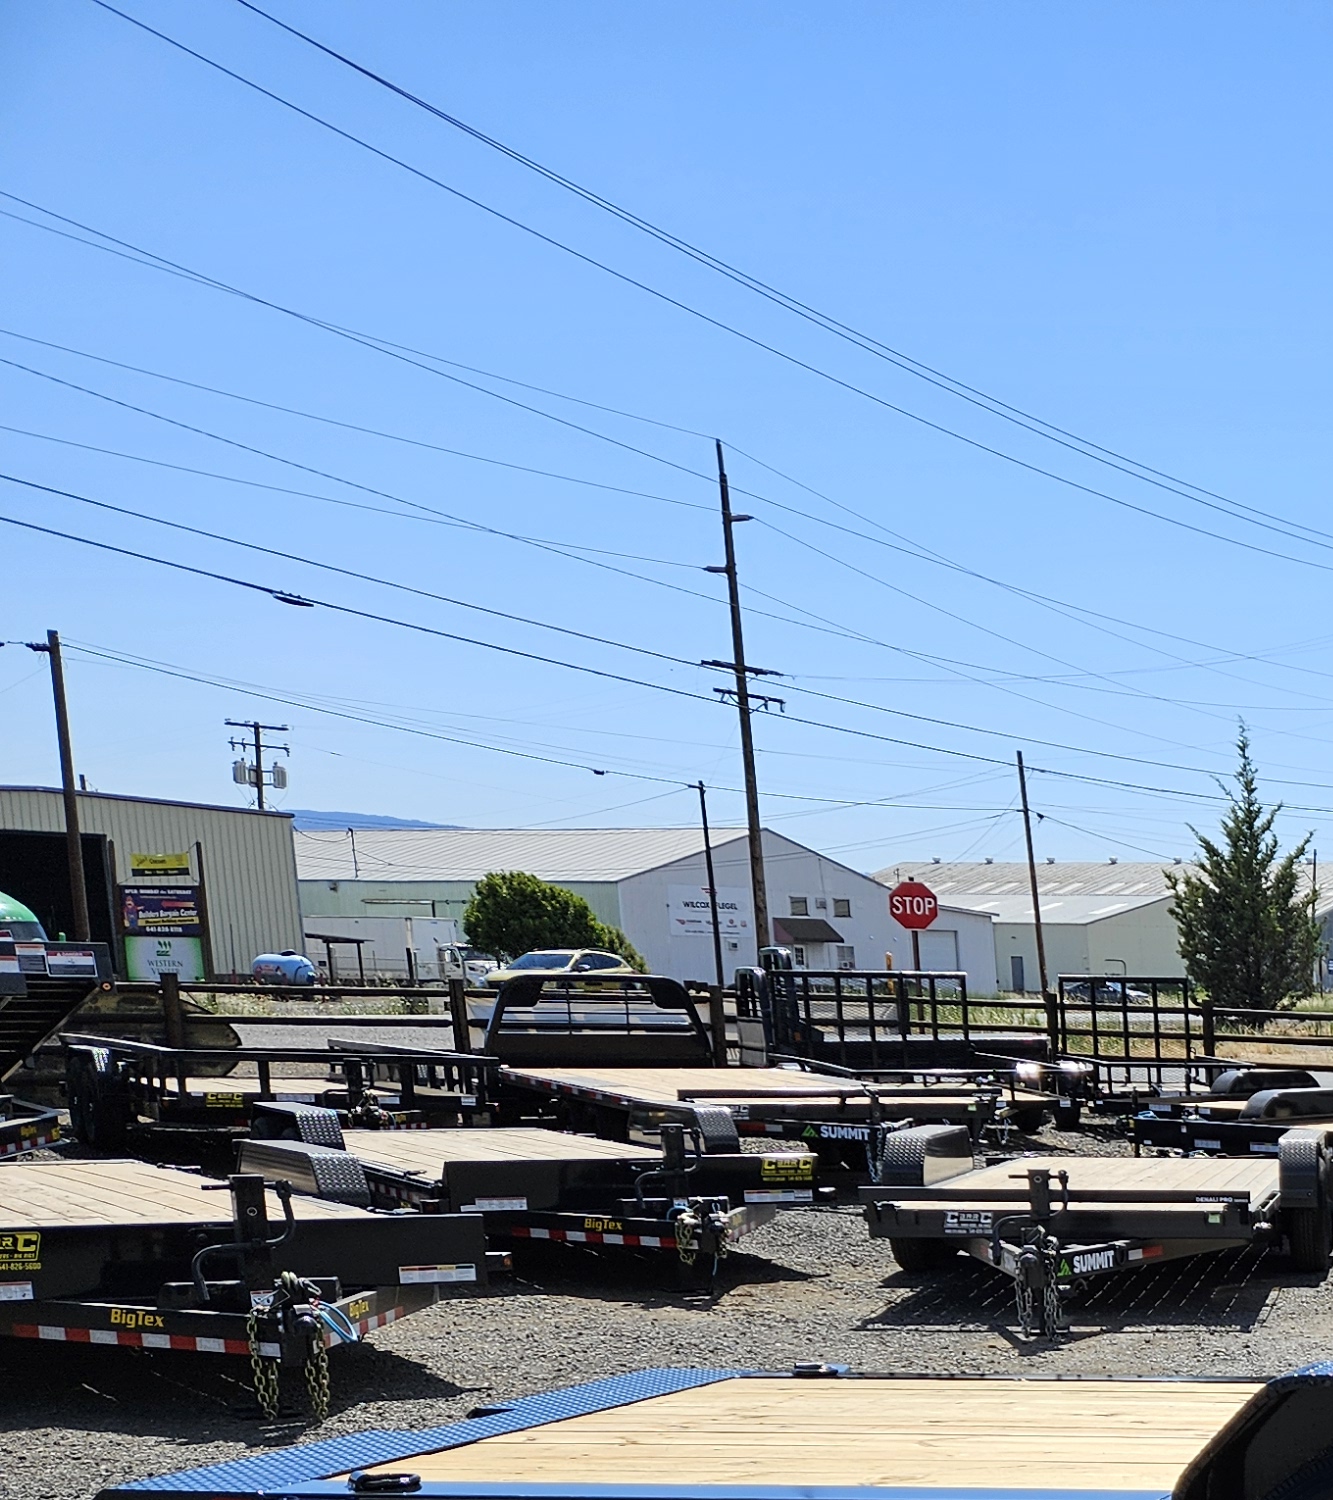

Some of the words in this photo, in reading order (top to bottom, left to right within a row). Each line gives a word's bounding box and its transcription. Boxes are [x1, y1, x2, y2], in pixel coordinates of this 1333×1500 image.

[683, 901, 710, 909] WILCOX
[892, 895, 935, 915] STOP
[147, 959, 184, 968] WESTERN
[820, 1125, 871, 1141] SUMMIT
[584, 1217, 623, 1231] BigTex
[1073, 1251, 1115, 1273] SUMMIT
[110, 1308, 165, 1329] BigTex
